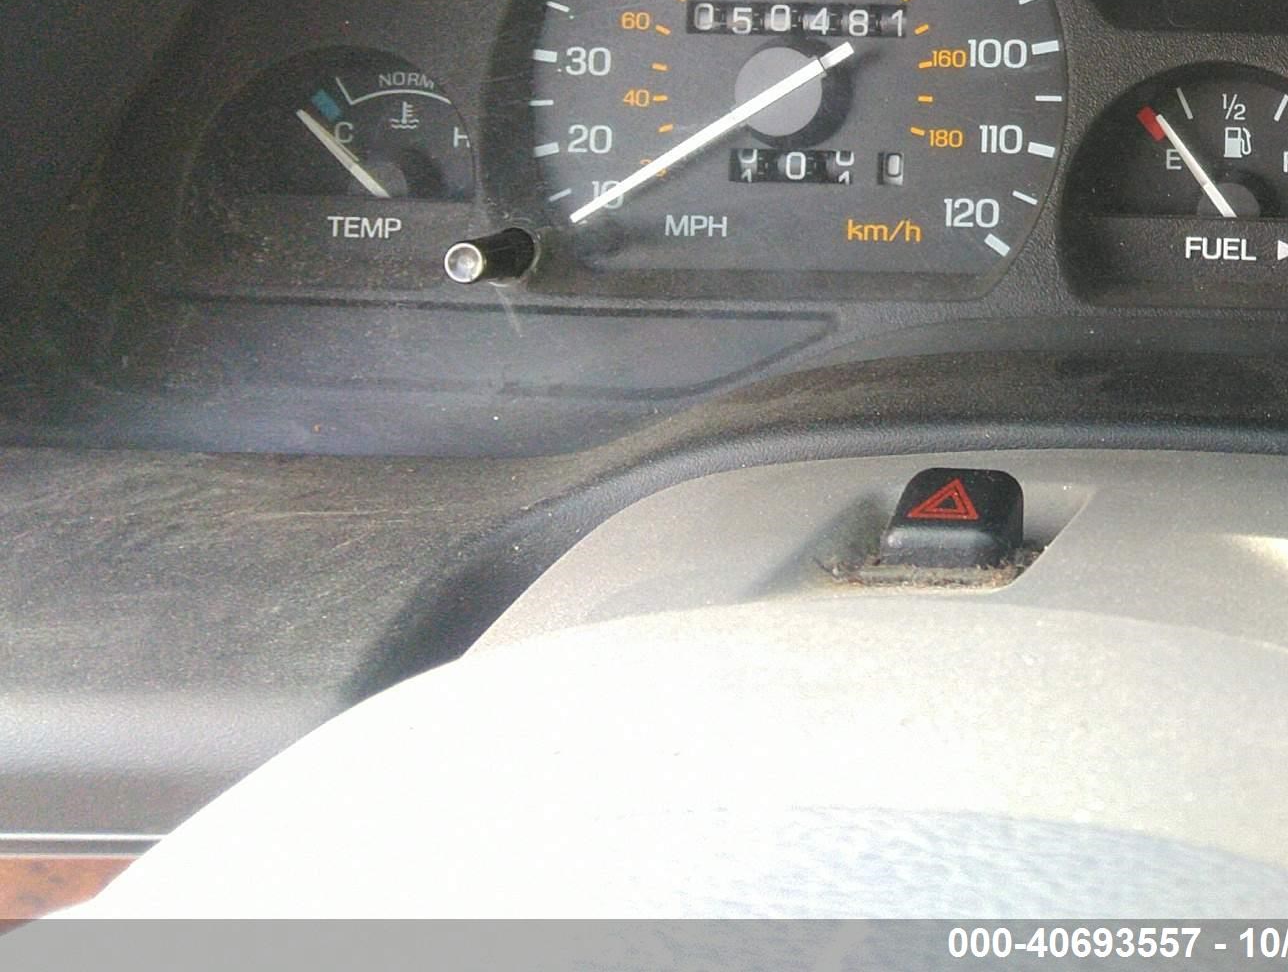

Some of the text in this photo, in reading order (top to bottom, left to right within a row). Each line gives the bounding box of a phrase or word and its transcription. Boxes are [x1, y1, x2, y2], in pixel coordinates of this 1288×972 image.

[620, 12, 651, 30] 60
[565, 47, 611, 76] 30
[932, 50, 966, 68] 160
[968, 39, 1027, 69] 100
[379, 72, 434, 89] NORM
[623, 89, 649, 107] 40
[335, 122, 353, 143] C
[568, 125, 612, 154] 20
[929, 130, 963, 148] 180
[979, 125, 1022, 154] 110
[1166, 149, 1182, 170] E
[944, 198, 1000, 228] 120
[327, 216, 402, 239] TEMP
[665, 215, 728, 237] MPH
[847, 219, 922, 242] km/h
[1185, 237, 1256, 260] FUEL
